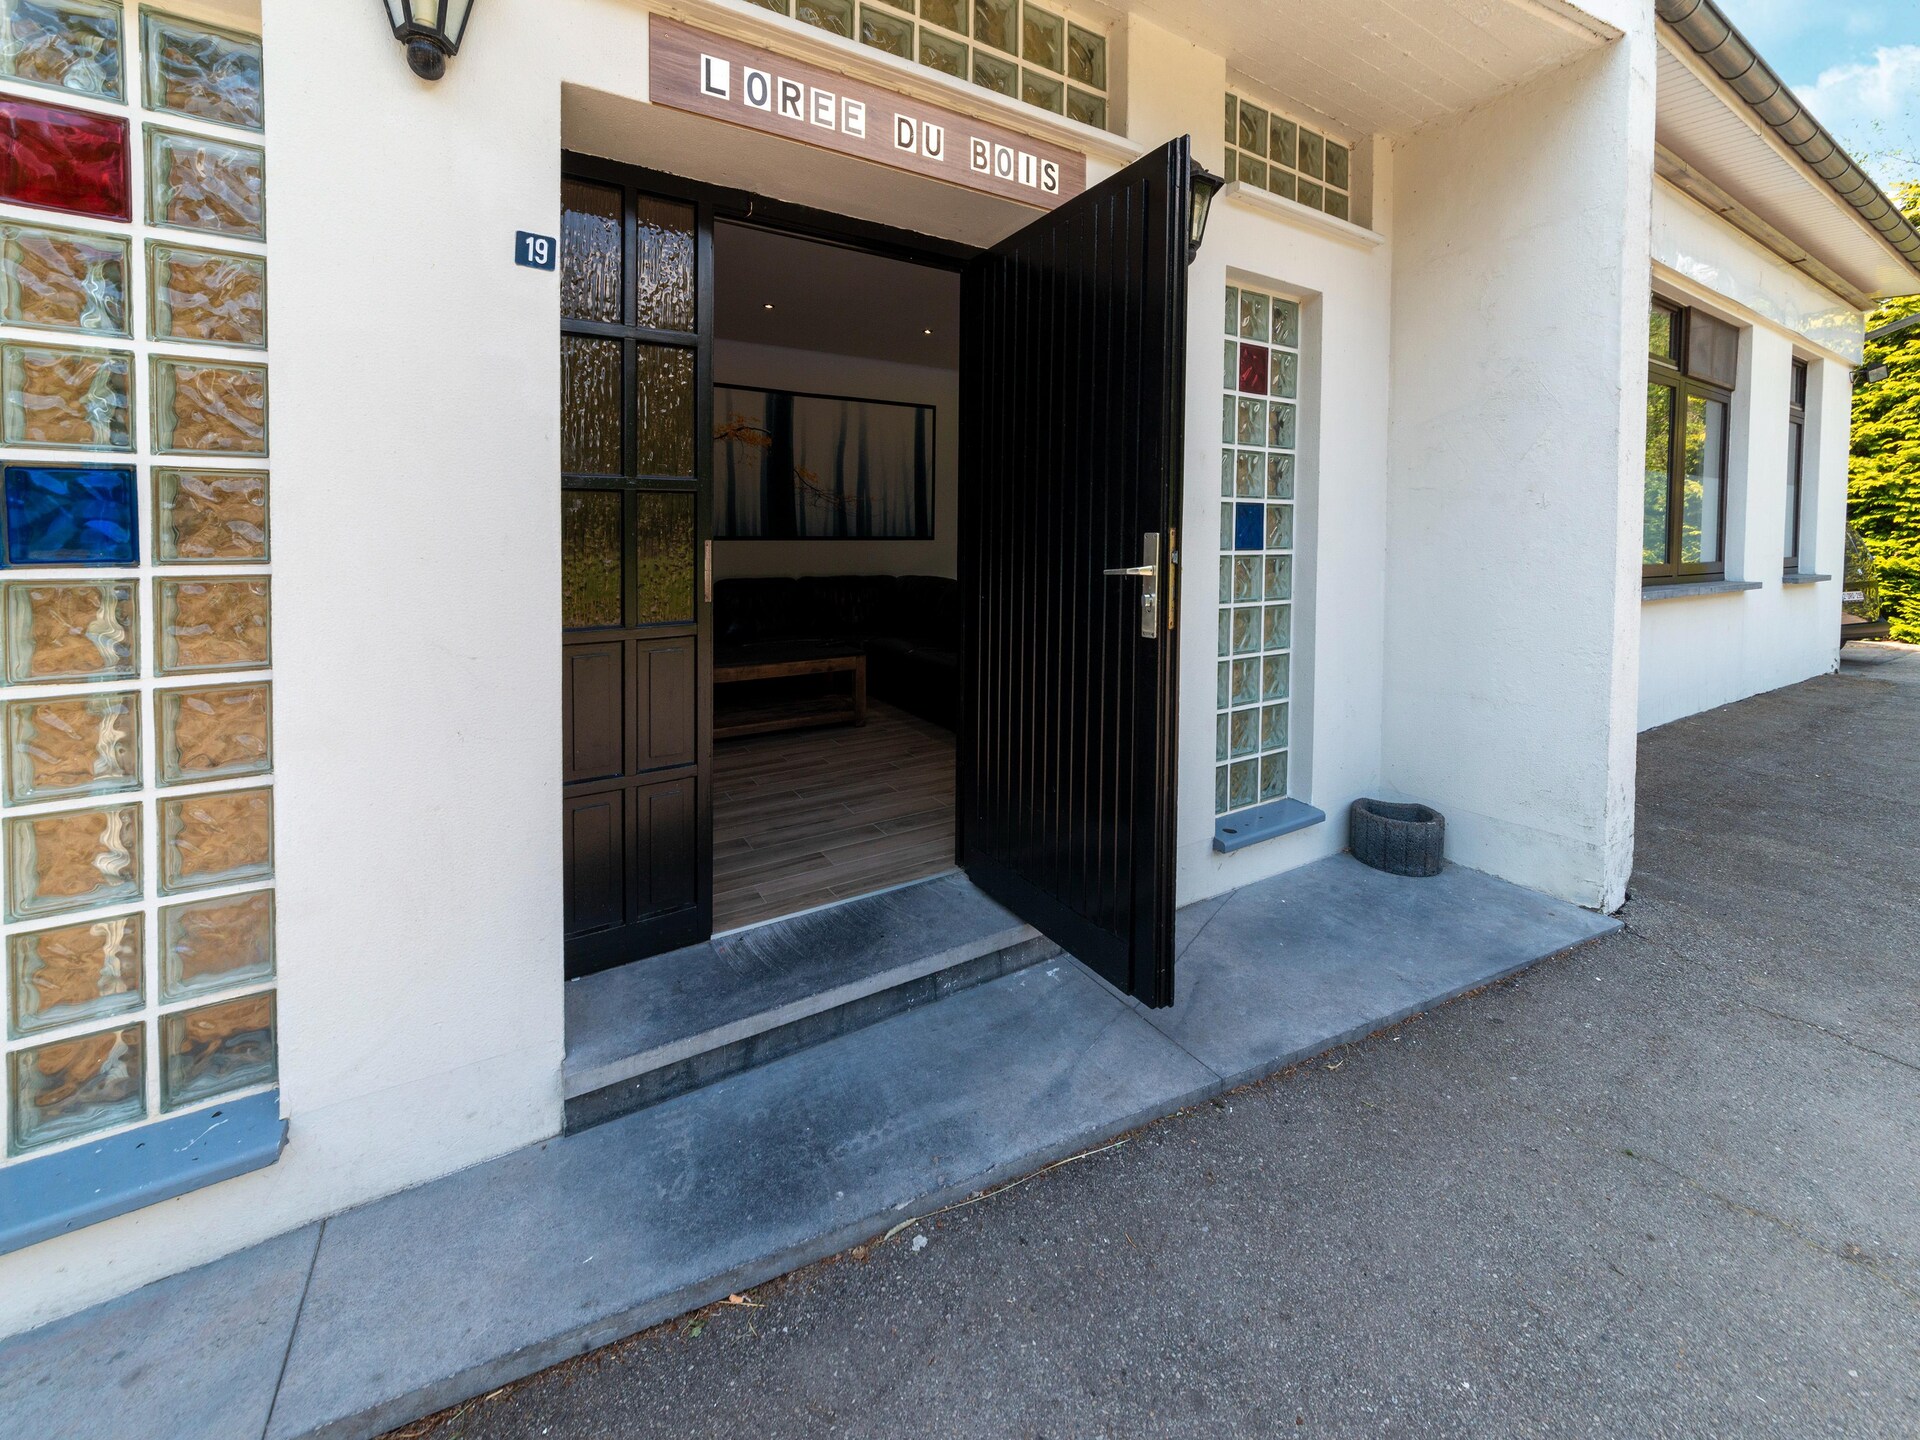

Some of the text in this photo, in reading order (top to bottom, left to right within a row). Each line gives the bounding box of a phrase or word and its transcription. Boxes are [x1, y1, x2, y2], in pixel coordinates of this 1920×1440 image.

[897, 116, 942, 157] DU
[972, 139, 1057, 192] BOIS
[525, 236, 549, 265] 19
